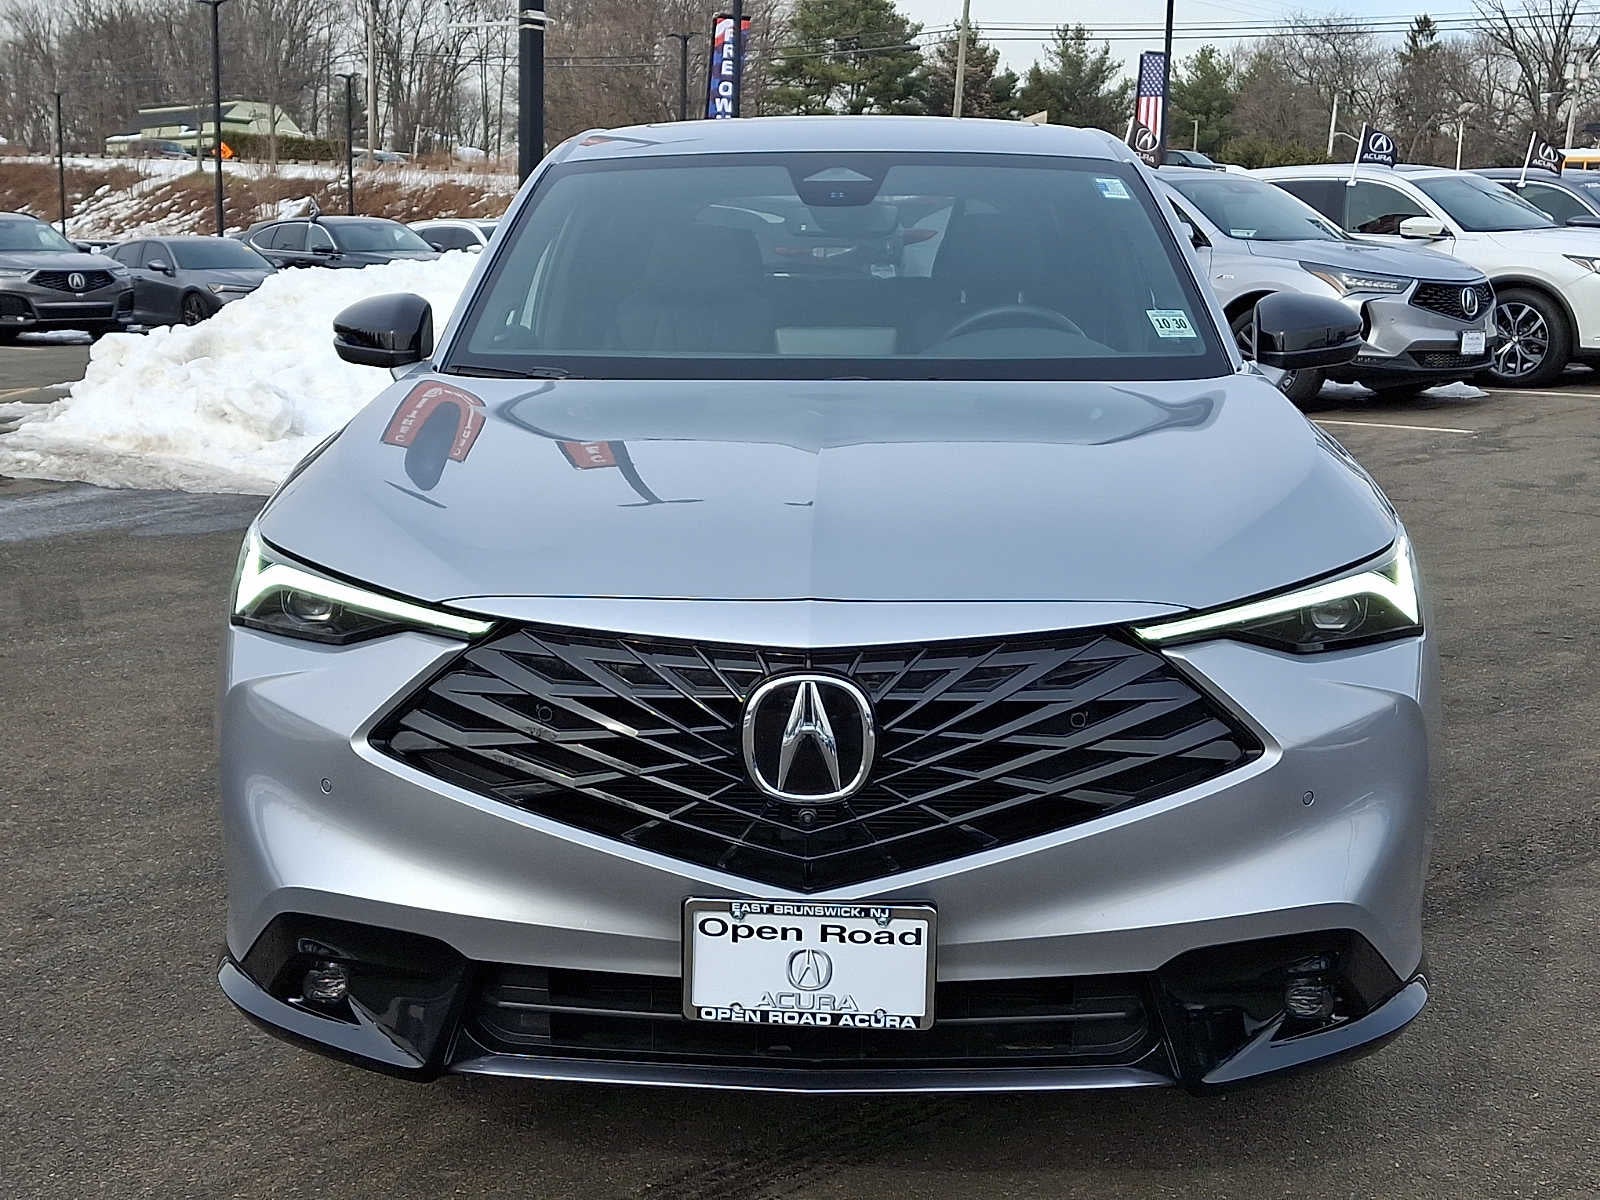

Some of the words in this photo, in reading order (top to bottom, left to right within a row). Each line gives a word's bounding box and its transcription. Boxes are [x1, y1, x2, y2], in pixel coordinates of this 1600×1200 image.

[1362, 152, 1393, 163] ACURA
[1155, 318, 1171, 329] 10
[1172, 318, 1188, 329] 30
[731, 902, 770, 914] EAST
[869, 908, 889, 918] NJ
[698, 917, 803, 943] Open
[820, 923, 922, 946] Road
[756, 991, 859, 1012] ACURA
[700, 1006, 762, 1023] OPEN
[768, 1010, 831, 1026] ROAD
[838, 1014, 917, 1029] ACURA
